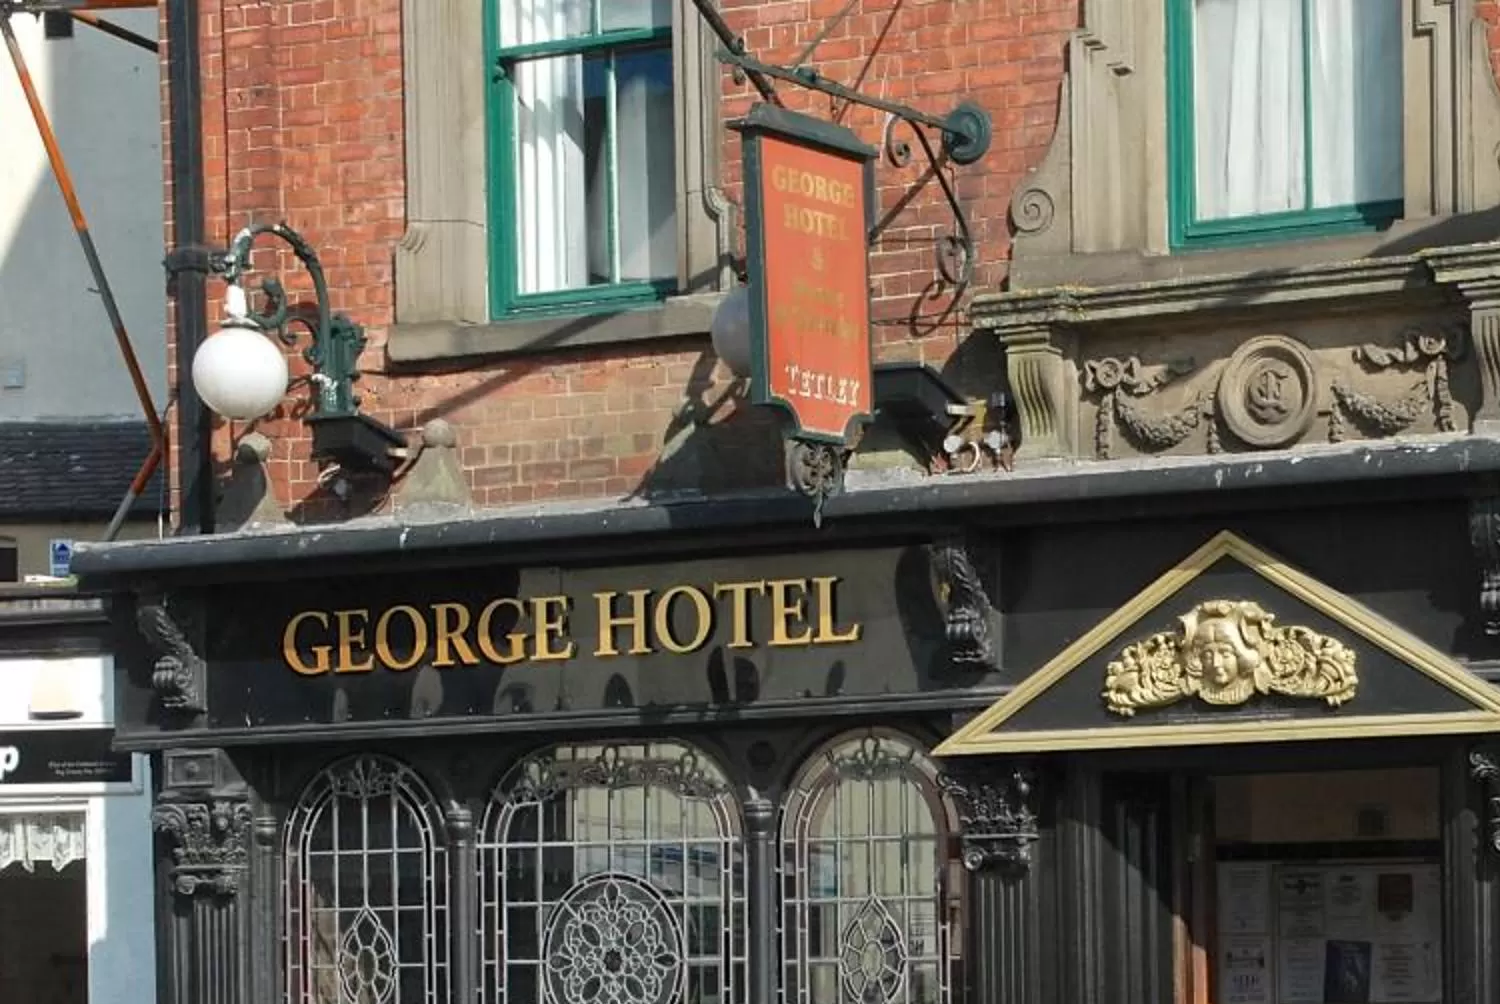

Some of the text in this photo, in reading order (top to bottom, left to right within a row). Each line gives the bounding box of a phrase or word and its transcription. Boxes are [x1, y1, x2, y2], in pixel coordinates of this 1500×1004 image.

[771, 163, 855, 208] GEORGE
[783, 203, 849, 241] HOTEL
[784, 363, 860, 407] TETLEY
[282, 575, 860, 677] GEORGE HOTEL
